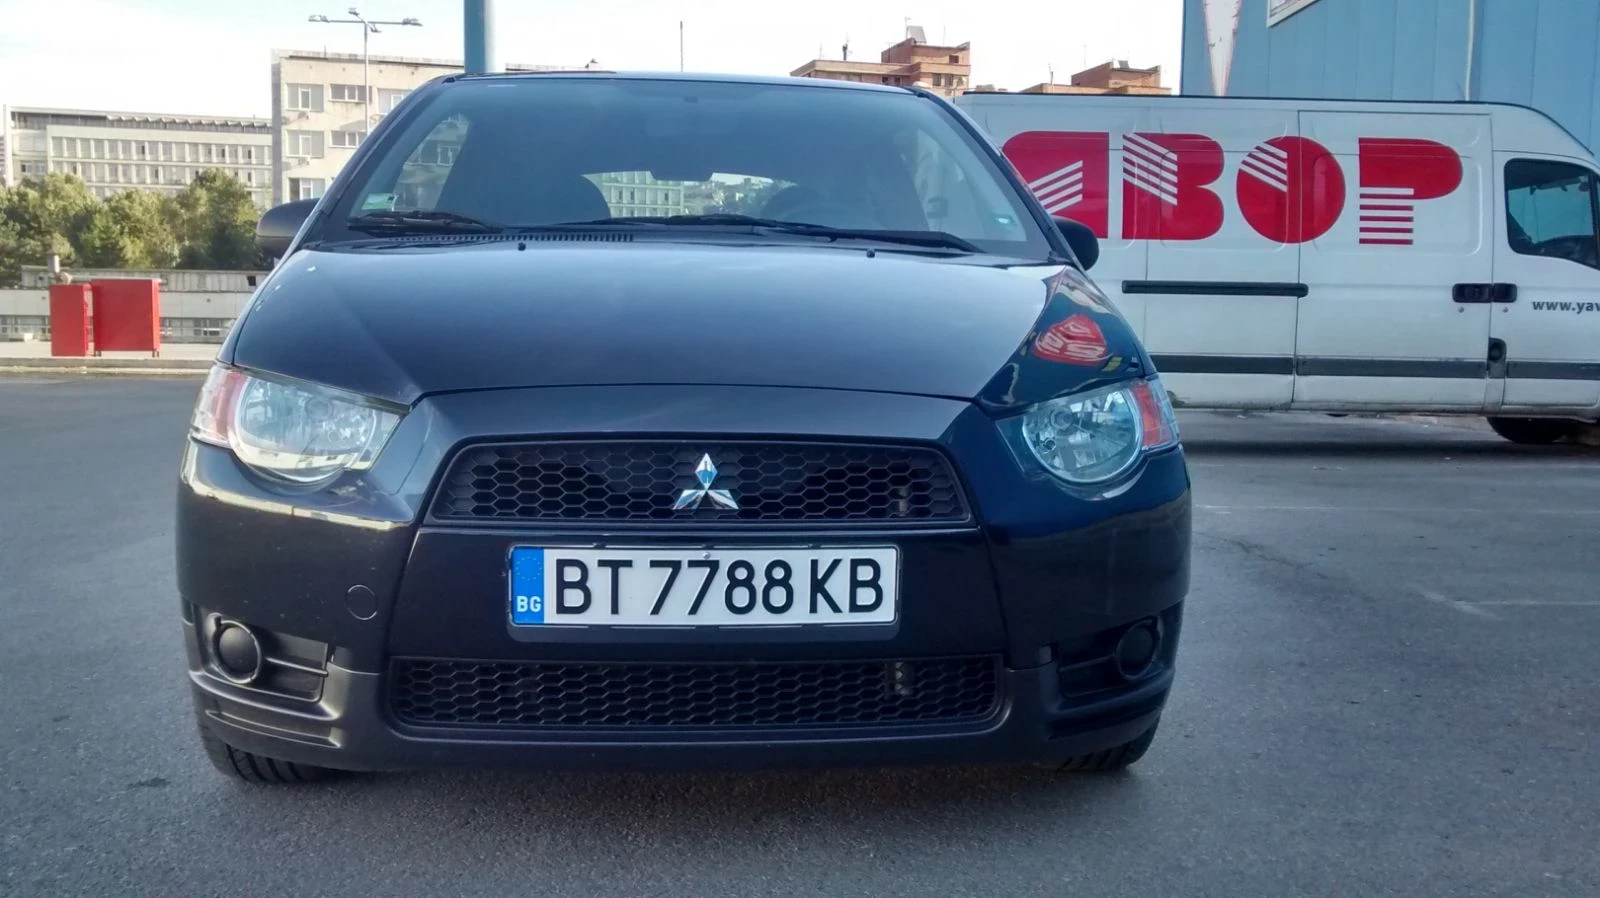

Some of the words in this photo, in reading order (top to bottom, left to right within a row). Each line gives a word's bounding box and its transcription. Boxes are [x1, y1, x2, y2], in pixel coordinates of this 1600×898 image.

[515, 595, 542, 613] BG
[554, 558, 633, 615] BT
[648, 559, 795, 616] 7788
[808, 558, 884, 614] KB
